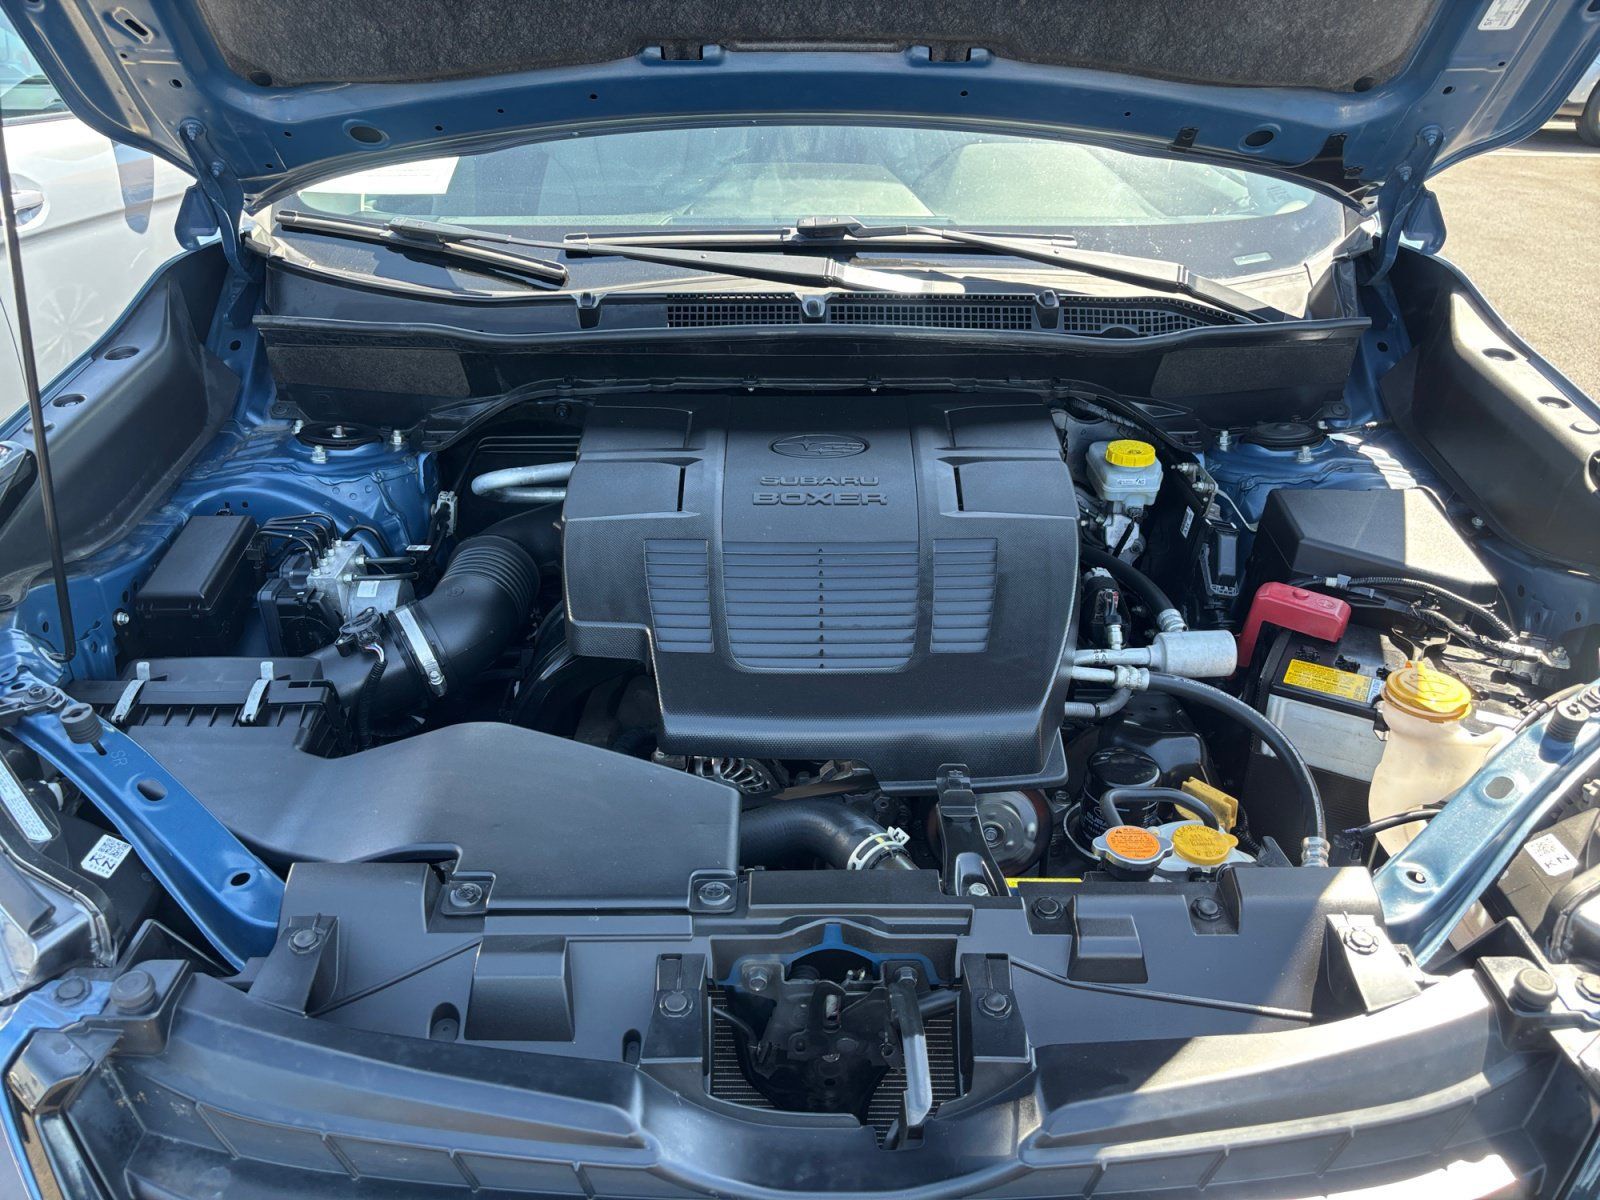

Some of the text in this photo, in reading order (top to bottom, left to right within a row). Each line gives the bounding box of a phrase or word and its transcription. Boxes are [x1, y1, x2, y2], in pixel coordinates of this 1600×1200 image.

[760, 475, 879, 487] SUBARU
[752, 491, 888, 506] BOXER
[89, 854, 117, 870] KN
[1544, 854, 1570, 869] KN
